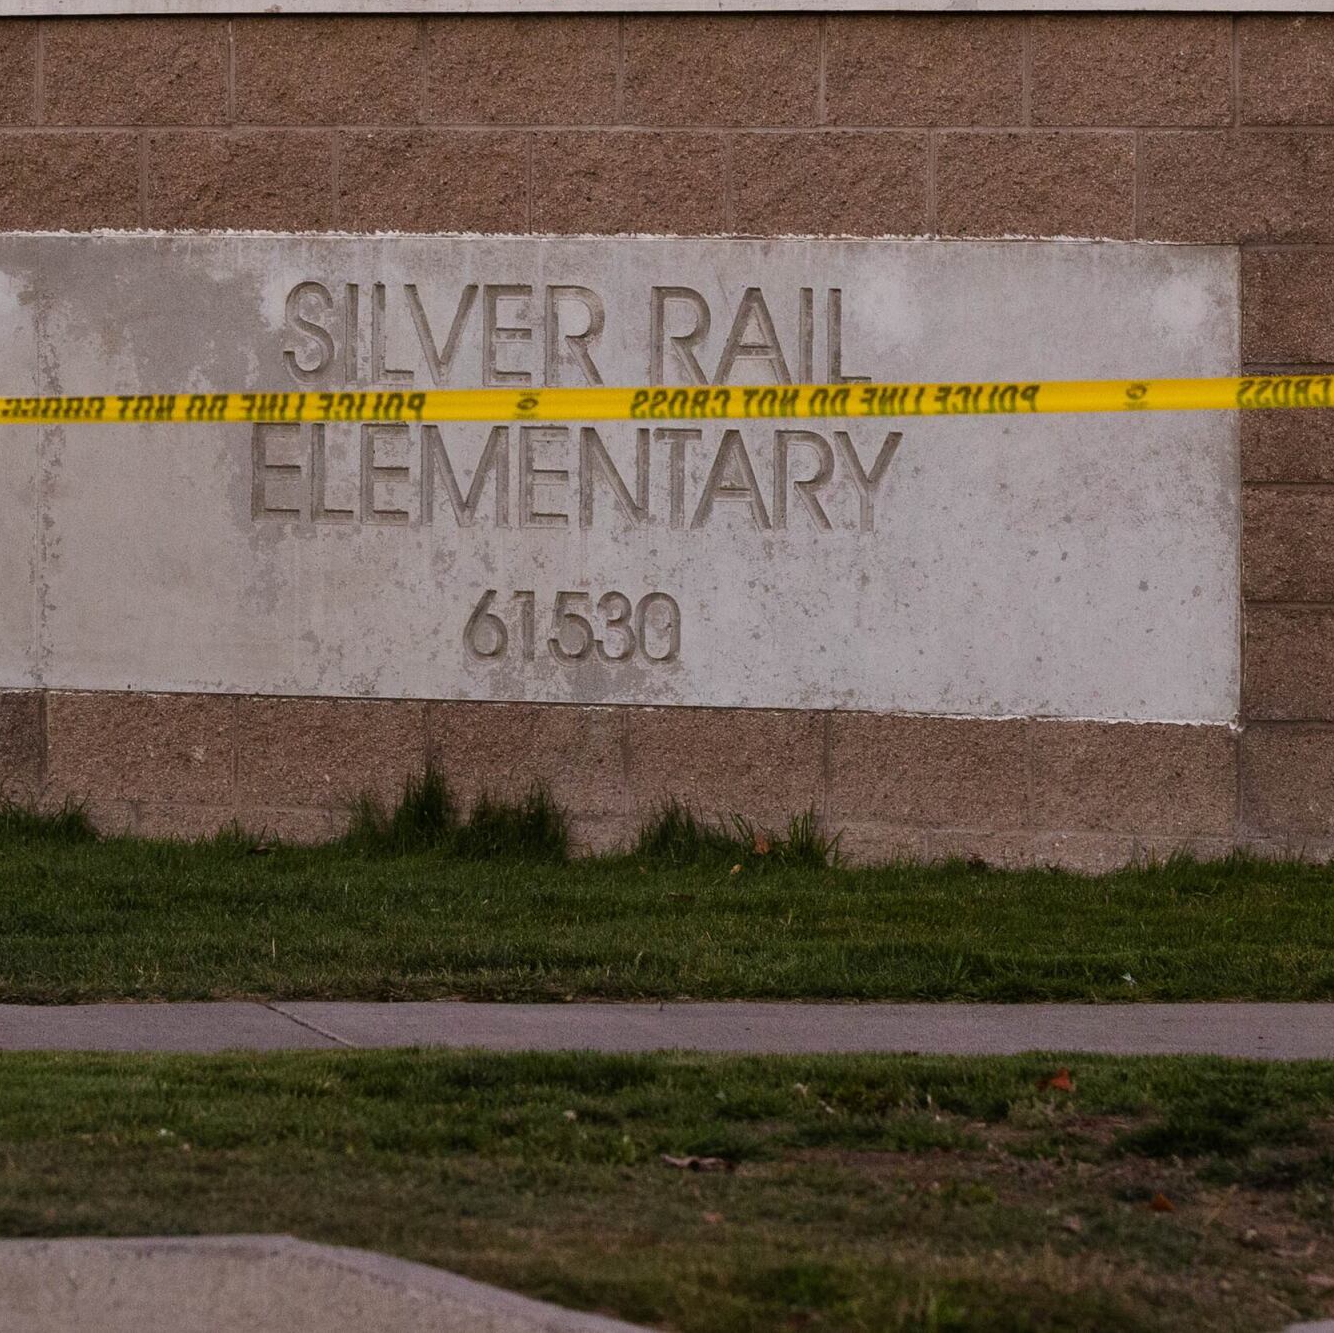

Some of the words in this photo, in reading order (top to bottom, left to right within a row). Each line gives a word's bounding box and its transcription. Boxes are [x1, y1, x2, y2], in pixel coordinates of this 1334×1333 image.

[281, 280, 606, 387] SILVER
[650, 285, 873, 387] RAIL
[252, 423, 903, 533] ELEMENTARY
[464, 589, 682, 666] 61530
